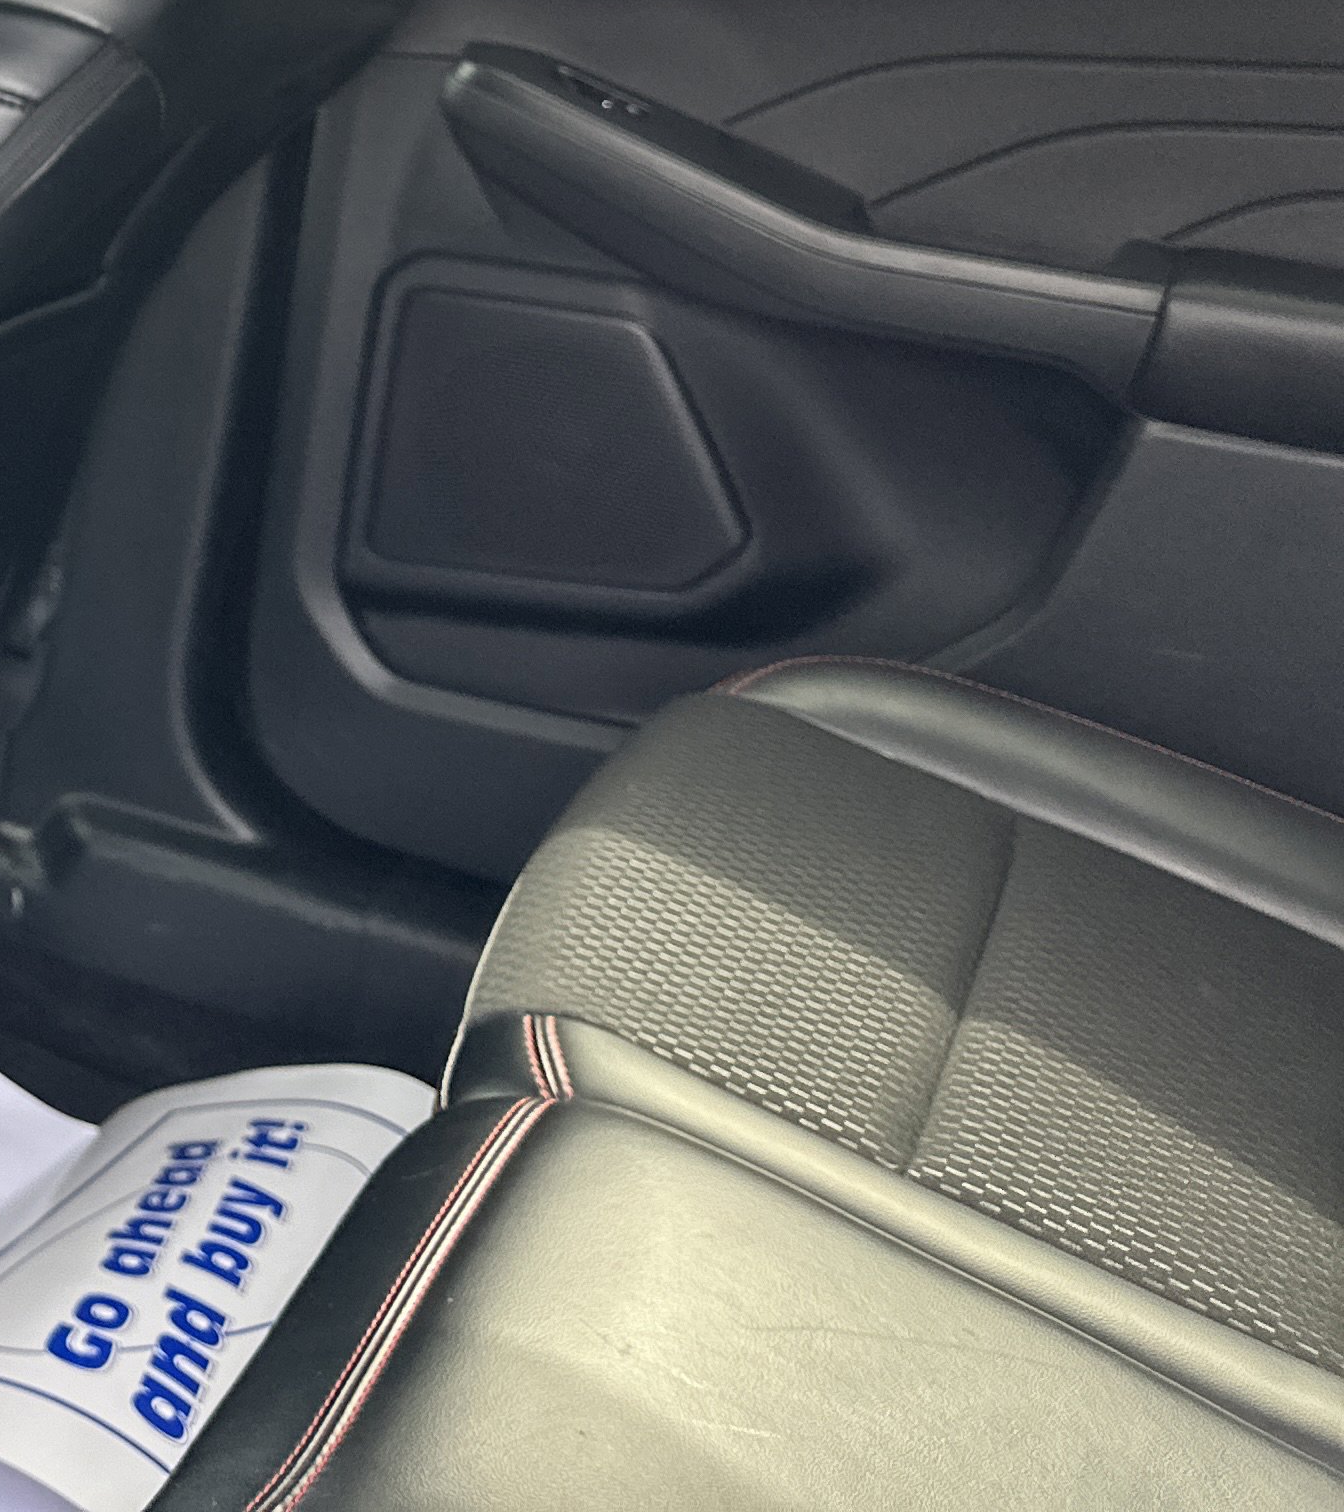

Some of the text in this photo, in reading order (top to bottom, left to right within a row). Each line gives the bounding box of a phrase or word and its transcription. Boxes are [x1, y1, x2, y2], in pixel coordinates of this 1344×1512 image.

[47, 1140, 218, 1369] Go ahead
[132, 1119, 306, 1439] and buy it!
